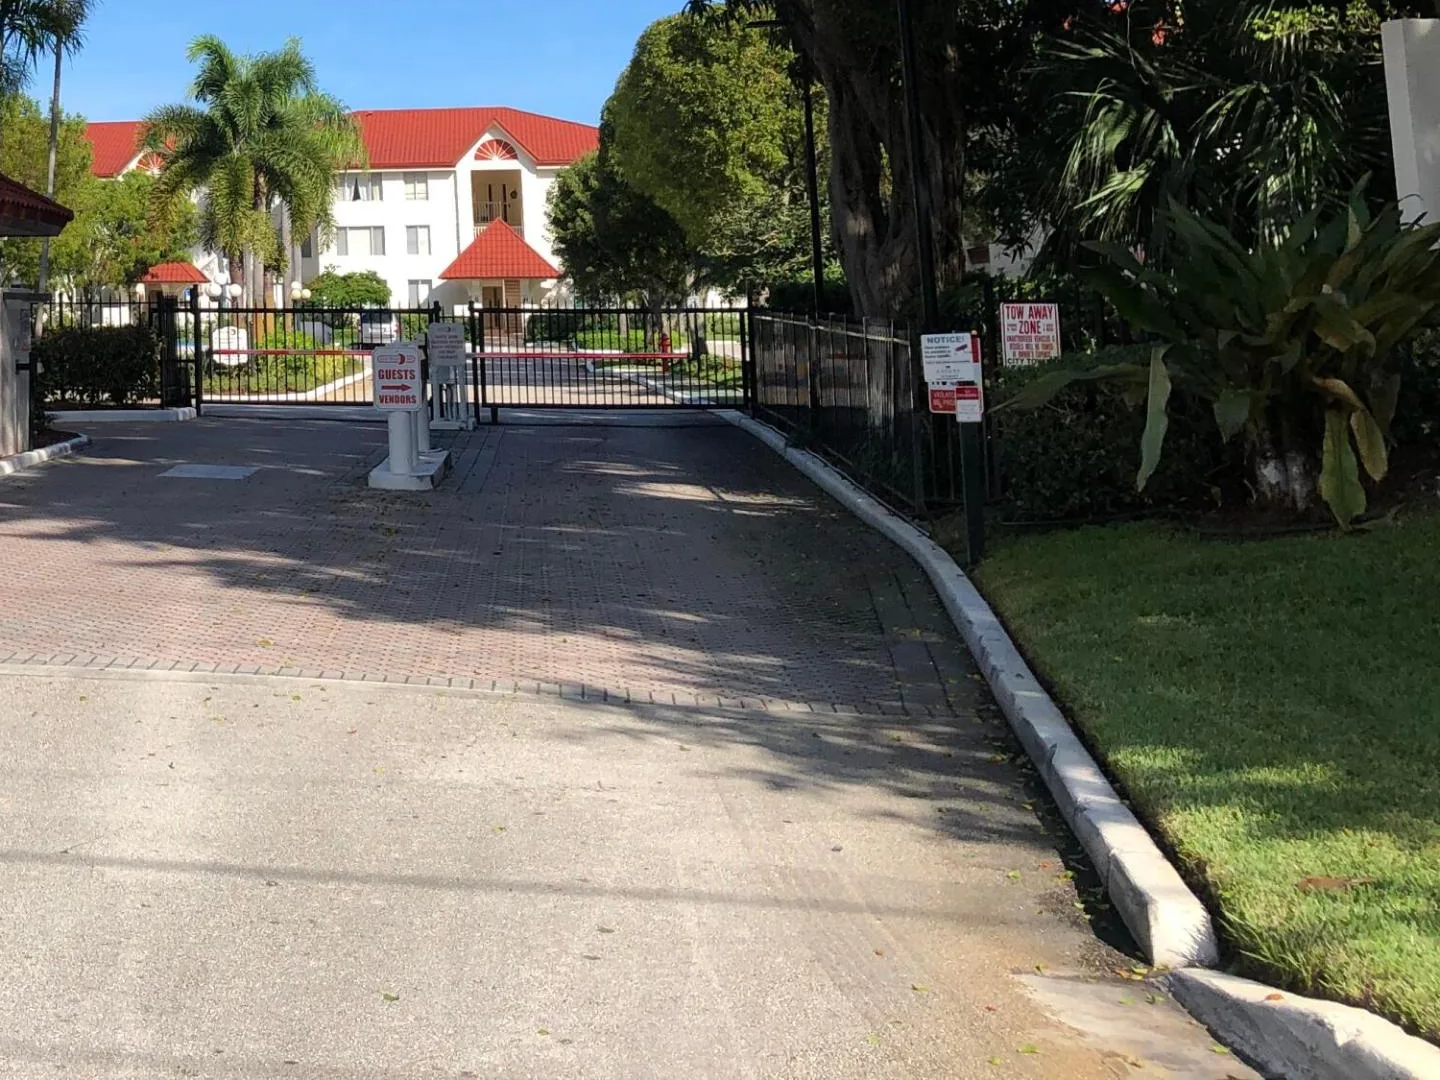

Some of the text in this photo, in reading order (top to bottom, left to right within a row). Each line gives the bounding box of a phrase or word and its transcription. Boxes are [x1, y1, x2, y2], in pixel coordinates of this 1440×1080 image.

[1005, 305, 1053, 320] TOW AWAY
[1018, 320, 1042, 334] ZONE
[377, 369, 416, 380] GUESTS
[378, 394, 417, 404] VENDORS
